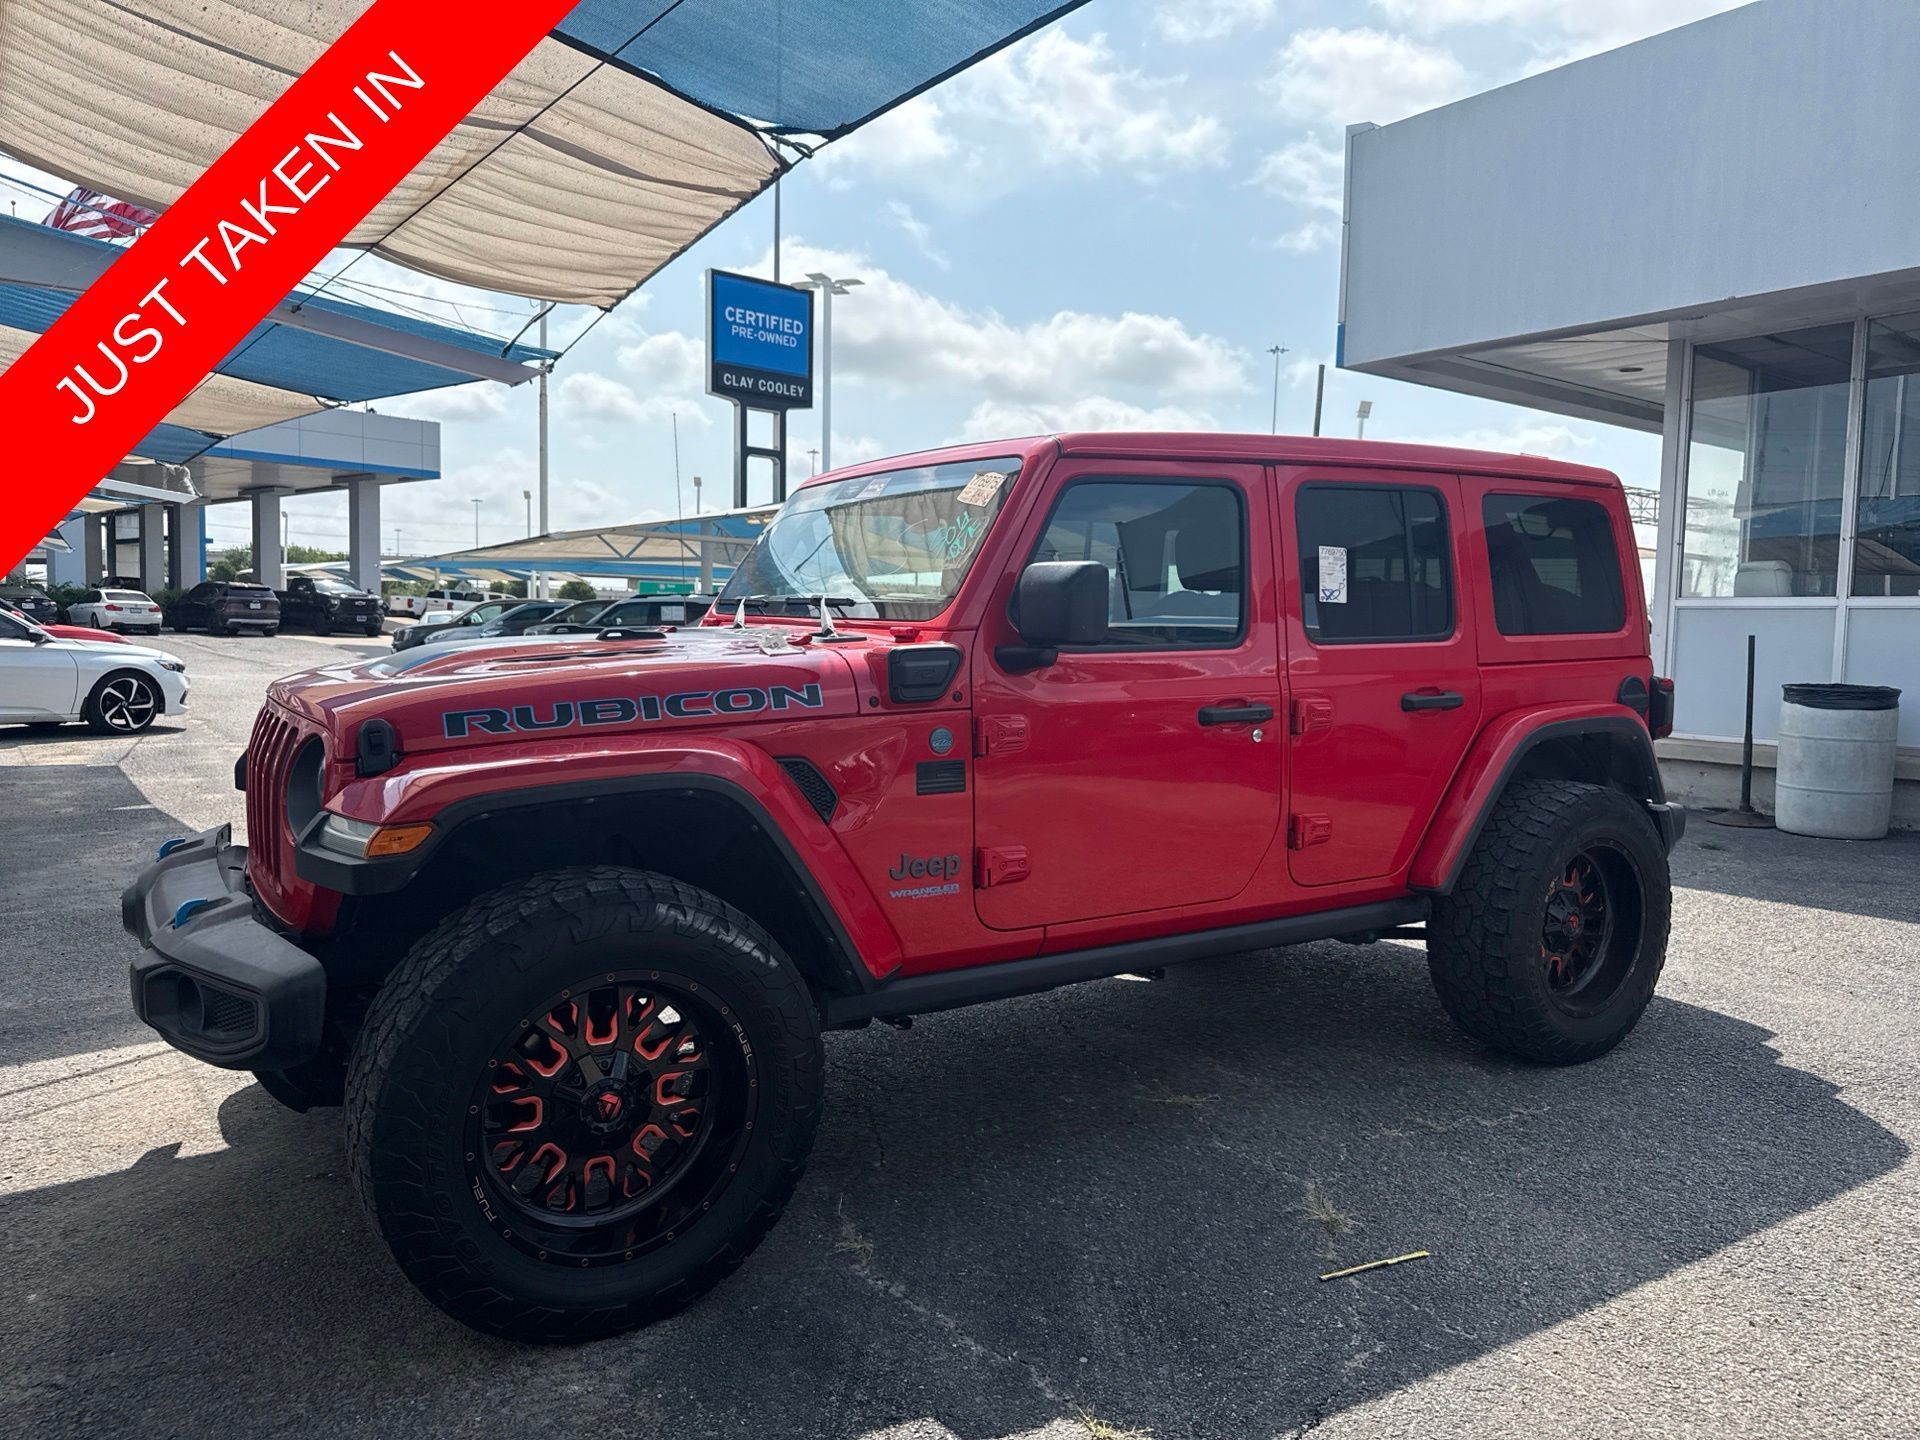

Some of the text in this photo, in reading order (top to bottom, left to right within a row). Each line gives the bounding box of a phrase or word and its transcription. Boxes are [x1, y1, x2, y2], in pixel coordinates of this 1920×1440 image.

[725, 306, 803, 334] CERTIFIED
[731, 325, 797, 348] PRE-OWNED
[723, 373, 804, 397] CLAY COOLEY
[443, 683, 823, 739] RUBICON
[889, 853, 961, 881] Jeep
[889, 883, 960, 898] WRANGLER
[732, 1022, 754, 1066] FUEL
[472, 1175, 497, 1222] FUEL
